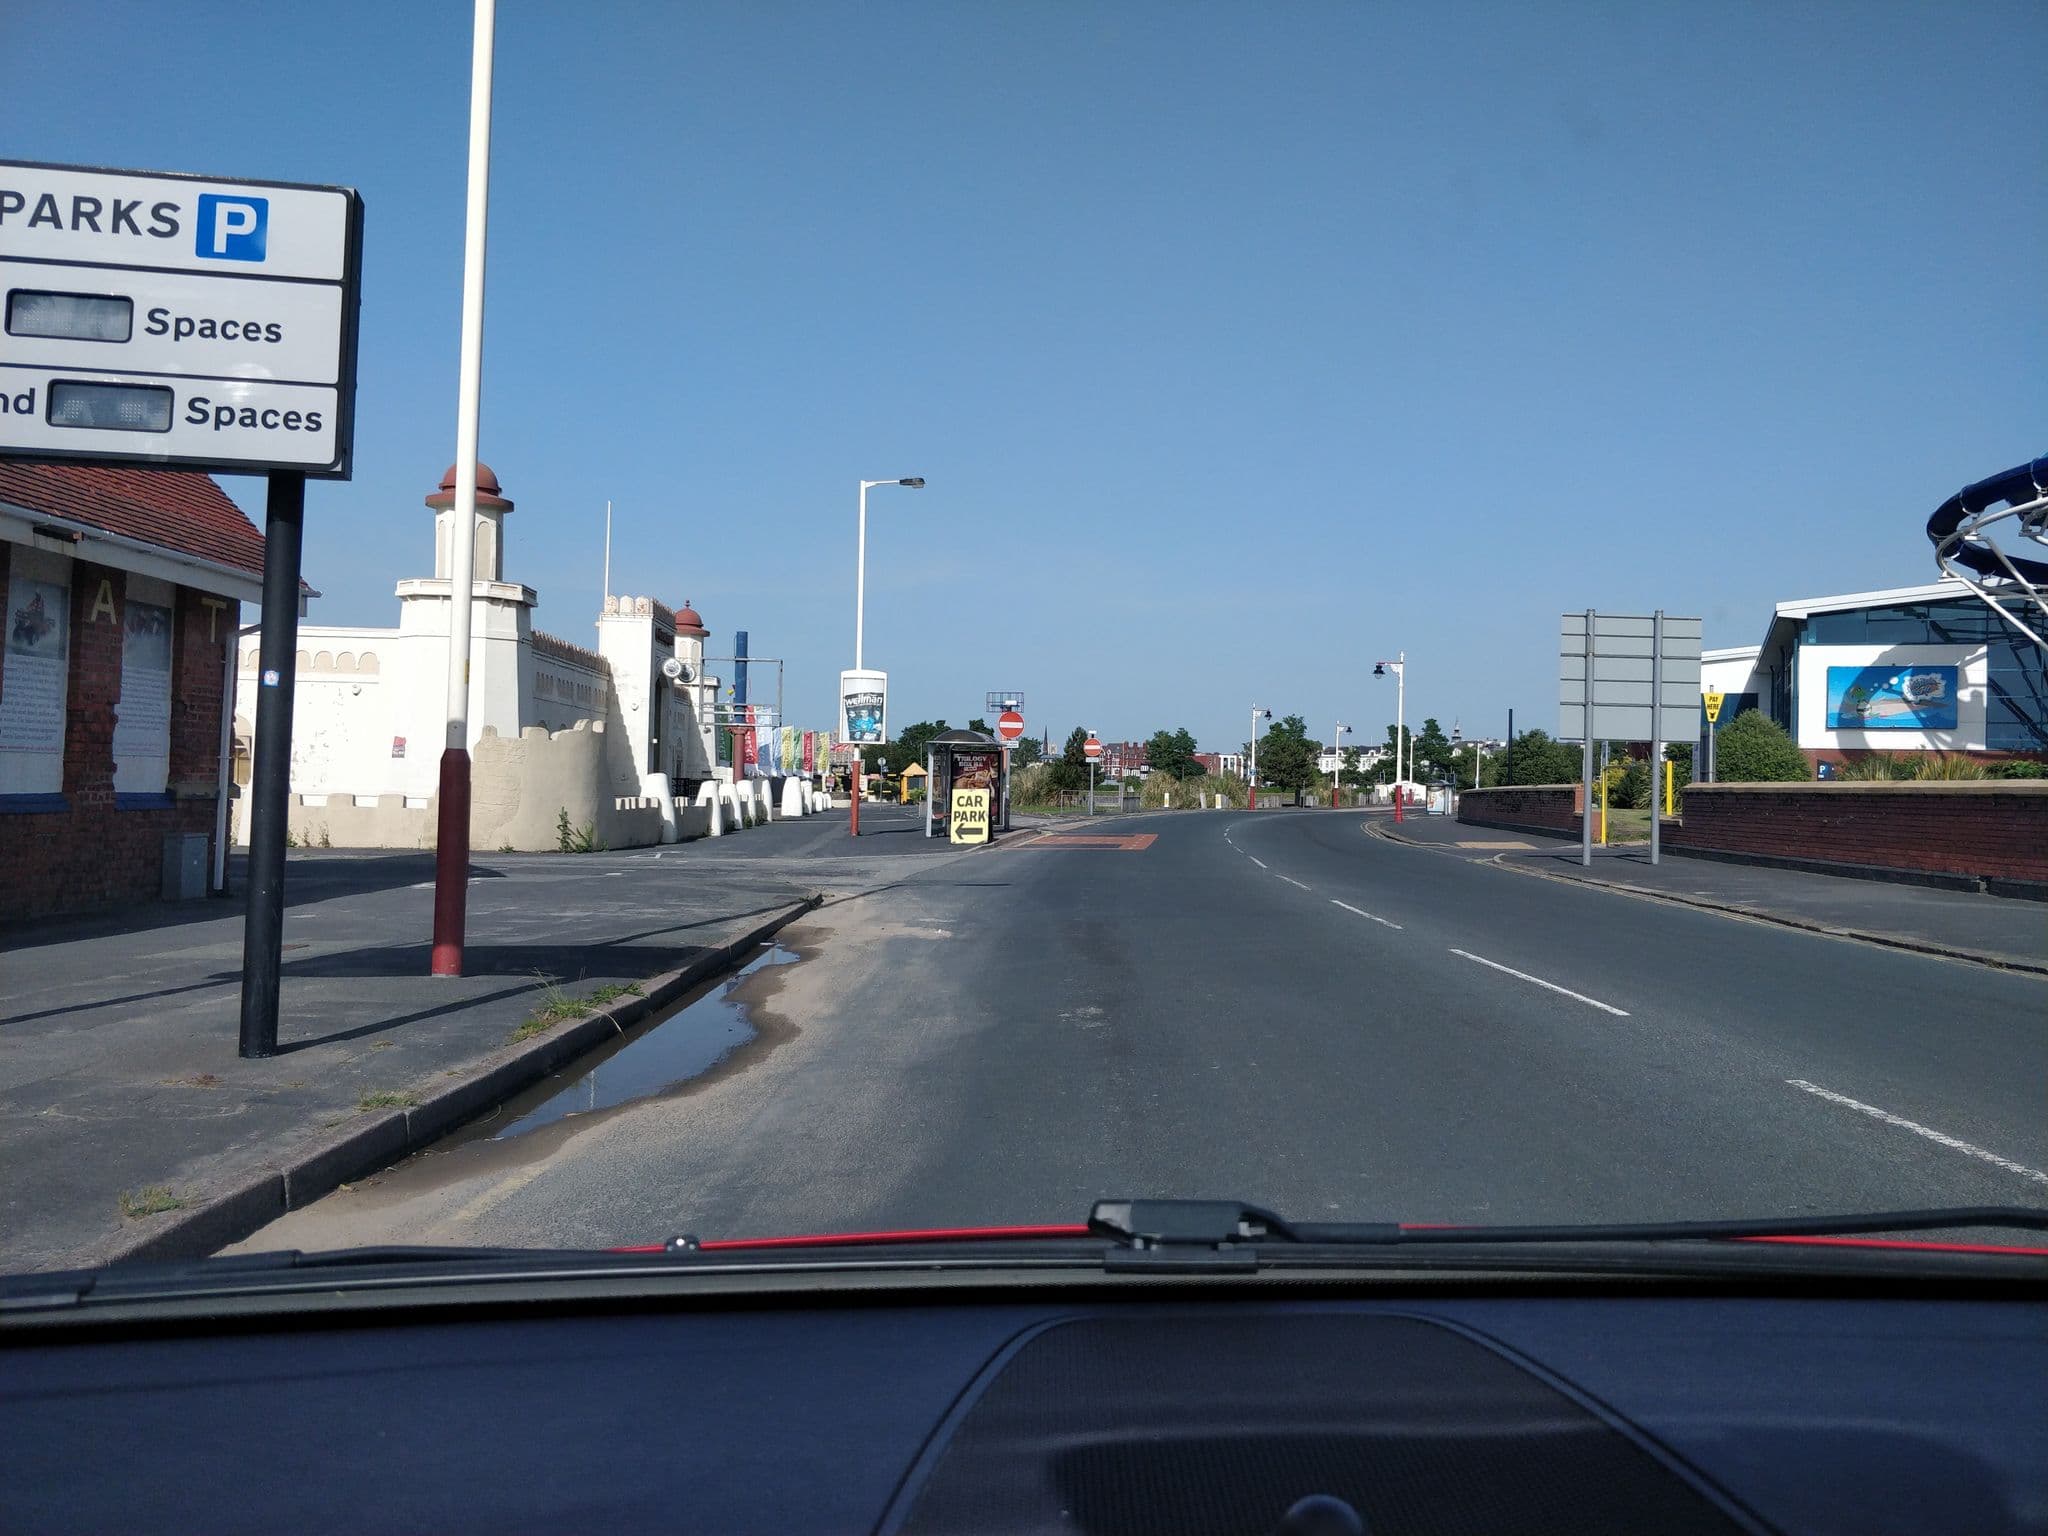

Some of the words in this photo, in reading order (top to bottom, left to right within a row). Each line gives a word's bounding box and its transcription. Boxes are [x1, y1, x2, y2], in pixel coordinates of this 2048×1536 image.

[0, 190, 181, 238] PARKS
[213, 202, 257, 253] P
[144, 308, 282, 343] Spaces
[185, 397, 322, 432] Spaces
[90, 580, 117, 624] A
[201, 597, 227, 642] T
[845, 694, 882, 706] wellman
[953, 810, 986, 822] PARK
[957, 795, 983, 807] CAR
